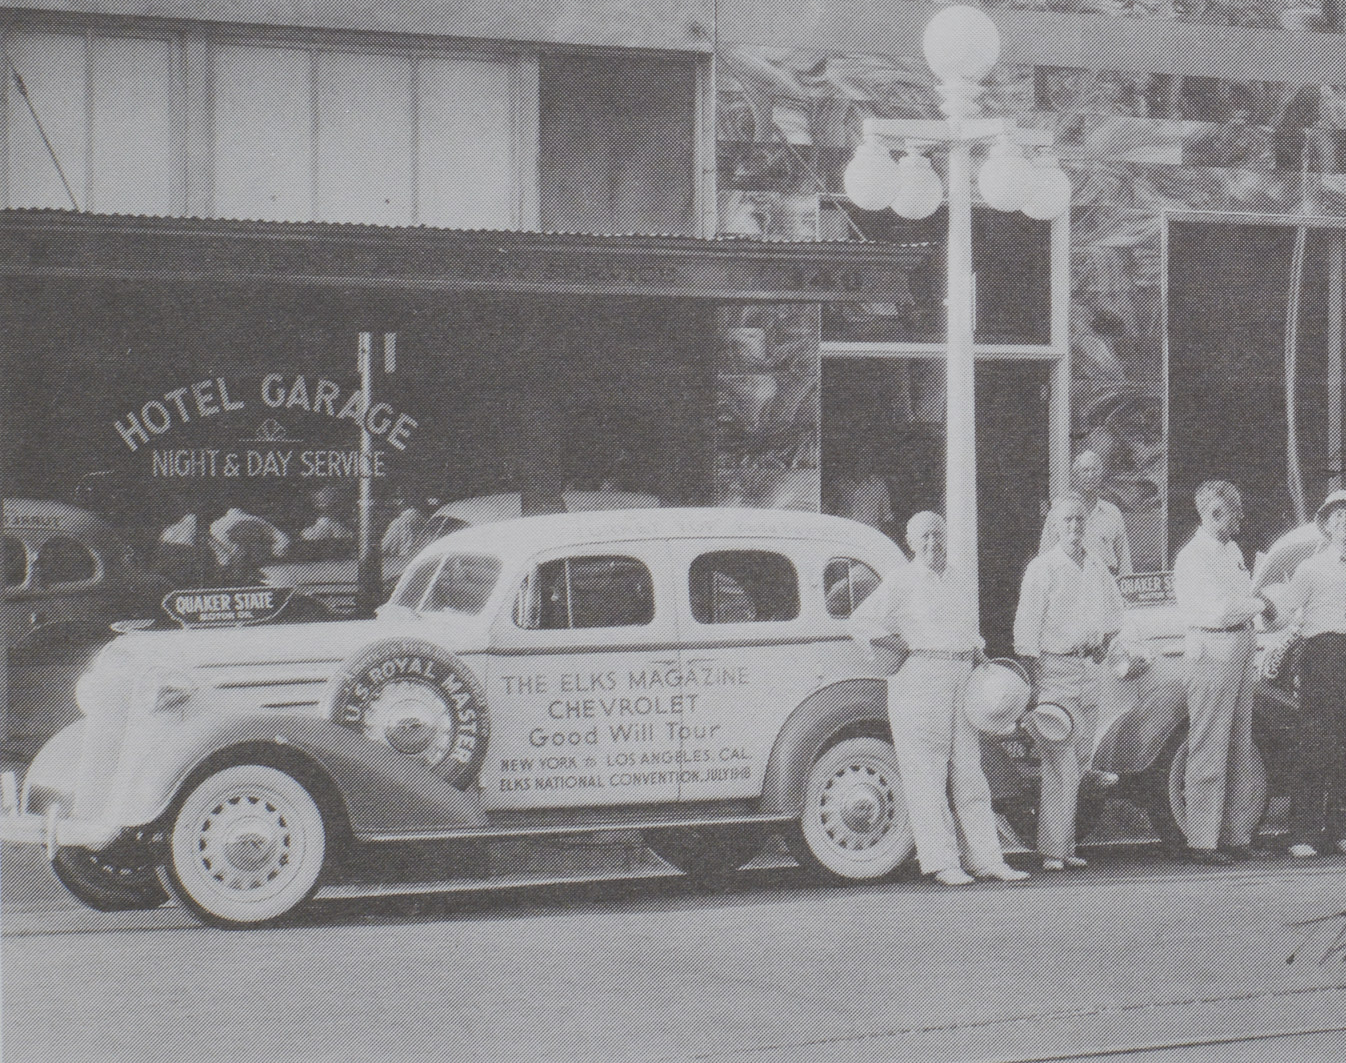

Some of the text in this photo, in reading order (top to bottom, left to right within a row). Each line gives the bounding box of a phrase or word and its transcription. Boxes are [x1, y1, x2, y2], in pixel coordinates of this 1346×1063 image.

[113, 373, 419, 452] HOTEL GARAGE
[152, 450, 386, 478] NIGHT & DAY SERVICE
[1120, 577, 1161, 594] QUAKER
[175, 591, 275, 615] QUAKER STATE
[501, 666, 750, 695] THE ELKS MAGAZINE
[368, 656, 436, 684] ROYAL
[440, 673, 478, 764] MASTER
[548, 694, 700, 720] CHEVROLET
[529, 721, 722, 748] Good Will Tour
[500, 757, 533, 772] NEW
[540, 756, 578, 771] YORK
[607, 751, 636, 767] LOS
[500, 777, 531, 792] ELKS
[535, 775, 602, 790] NATIONAL
